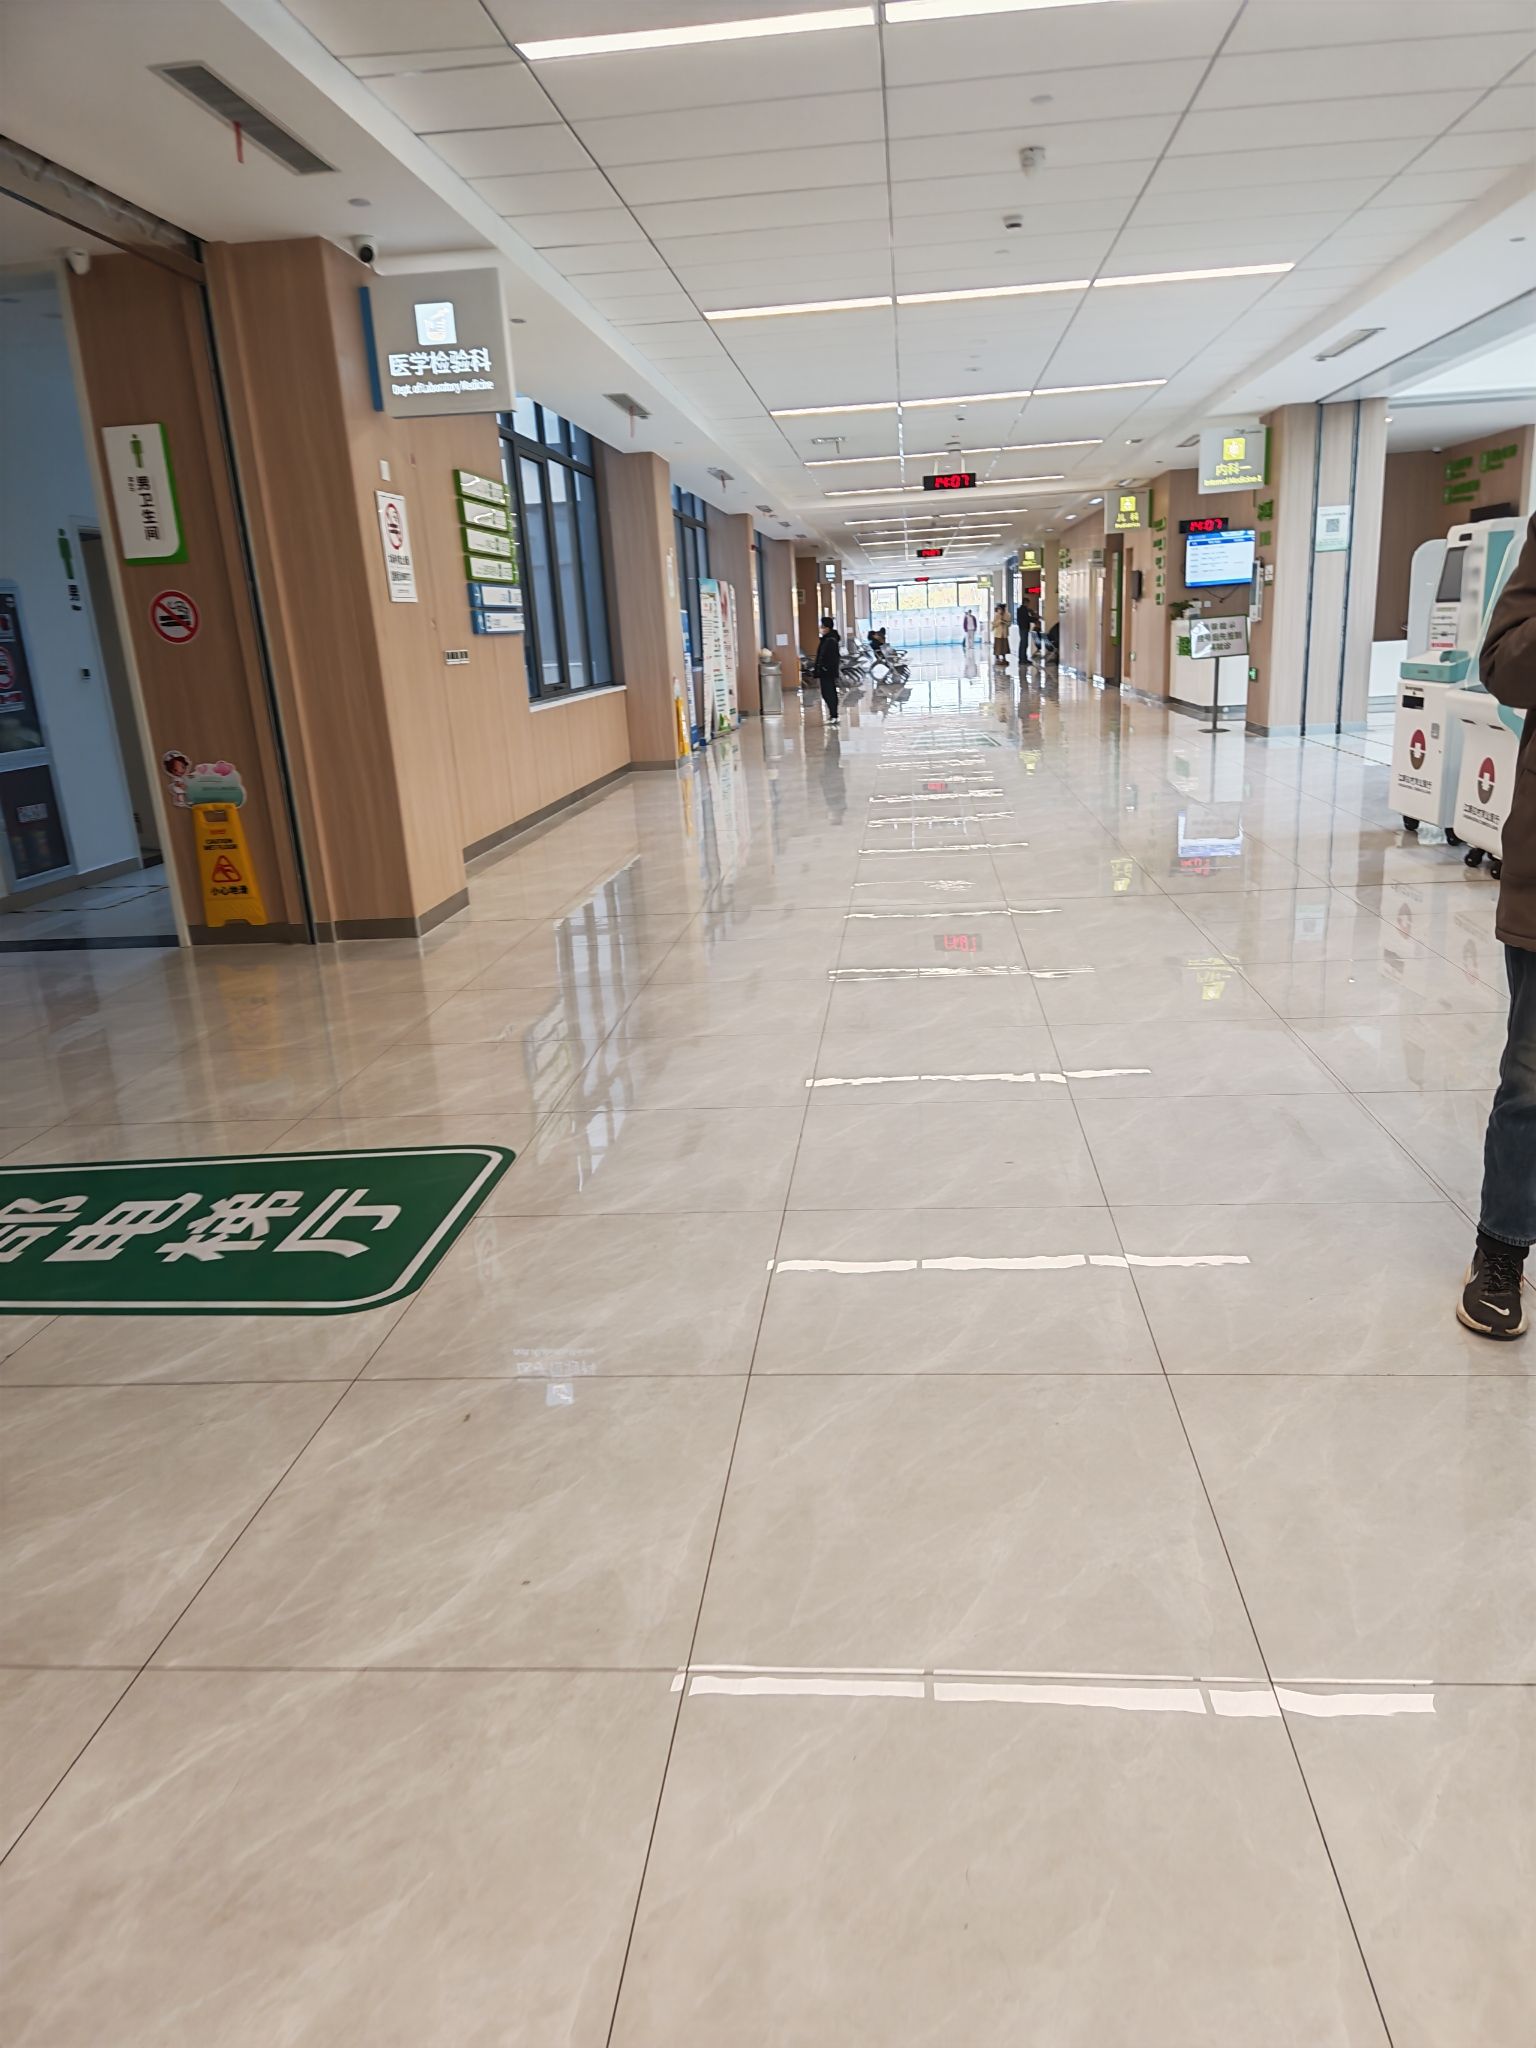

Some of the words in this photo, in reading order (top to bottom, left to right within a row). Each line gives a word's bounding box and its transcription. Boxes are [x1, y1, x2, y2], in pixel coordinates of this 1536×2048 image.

[388, 347, 492, 376] 医学检验科
[935, 474, 970, 489] 14:07
[1189, 518, 1223, 532] 14:07
[211, 886, 248, 896] 小心地滑
